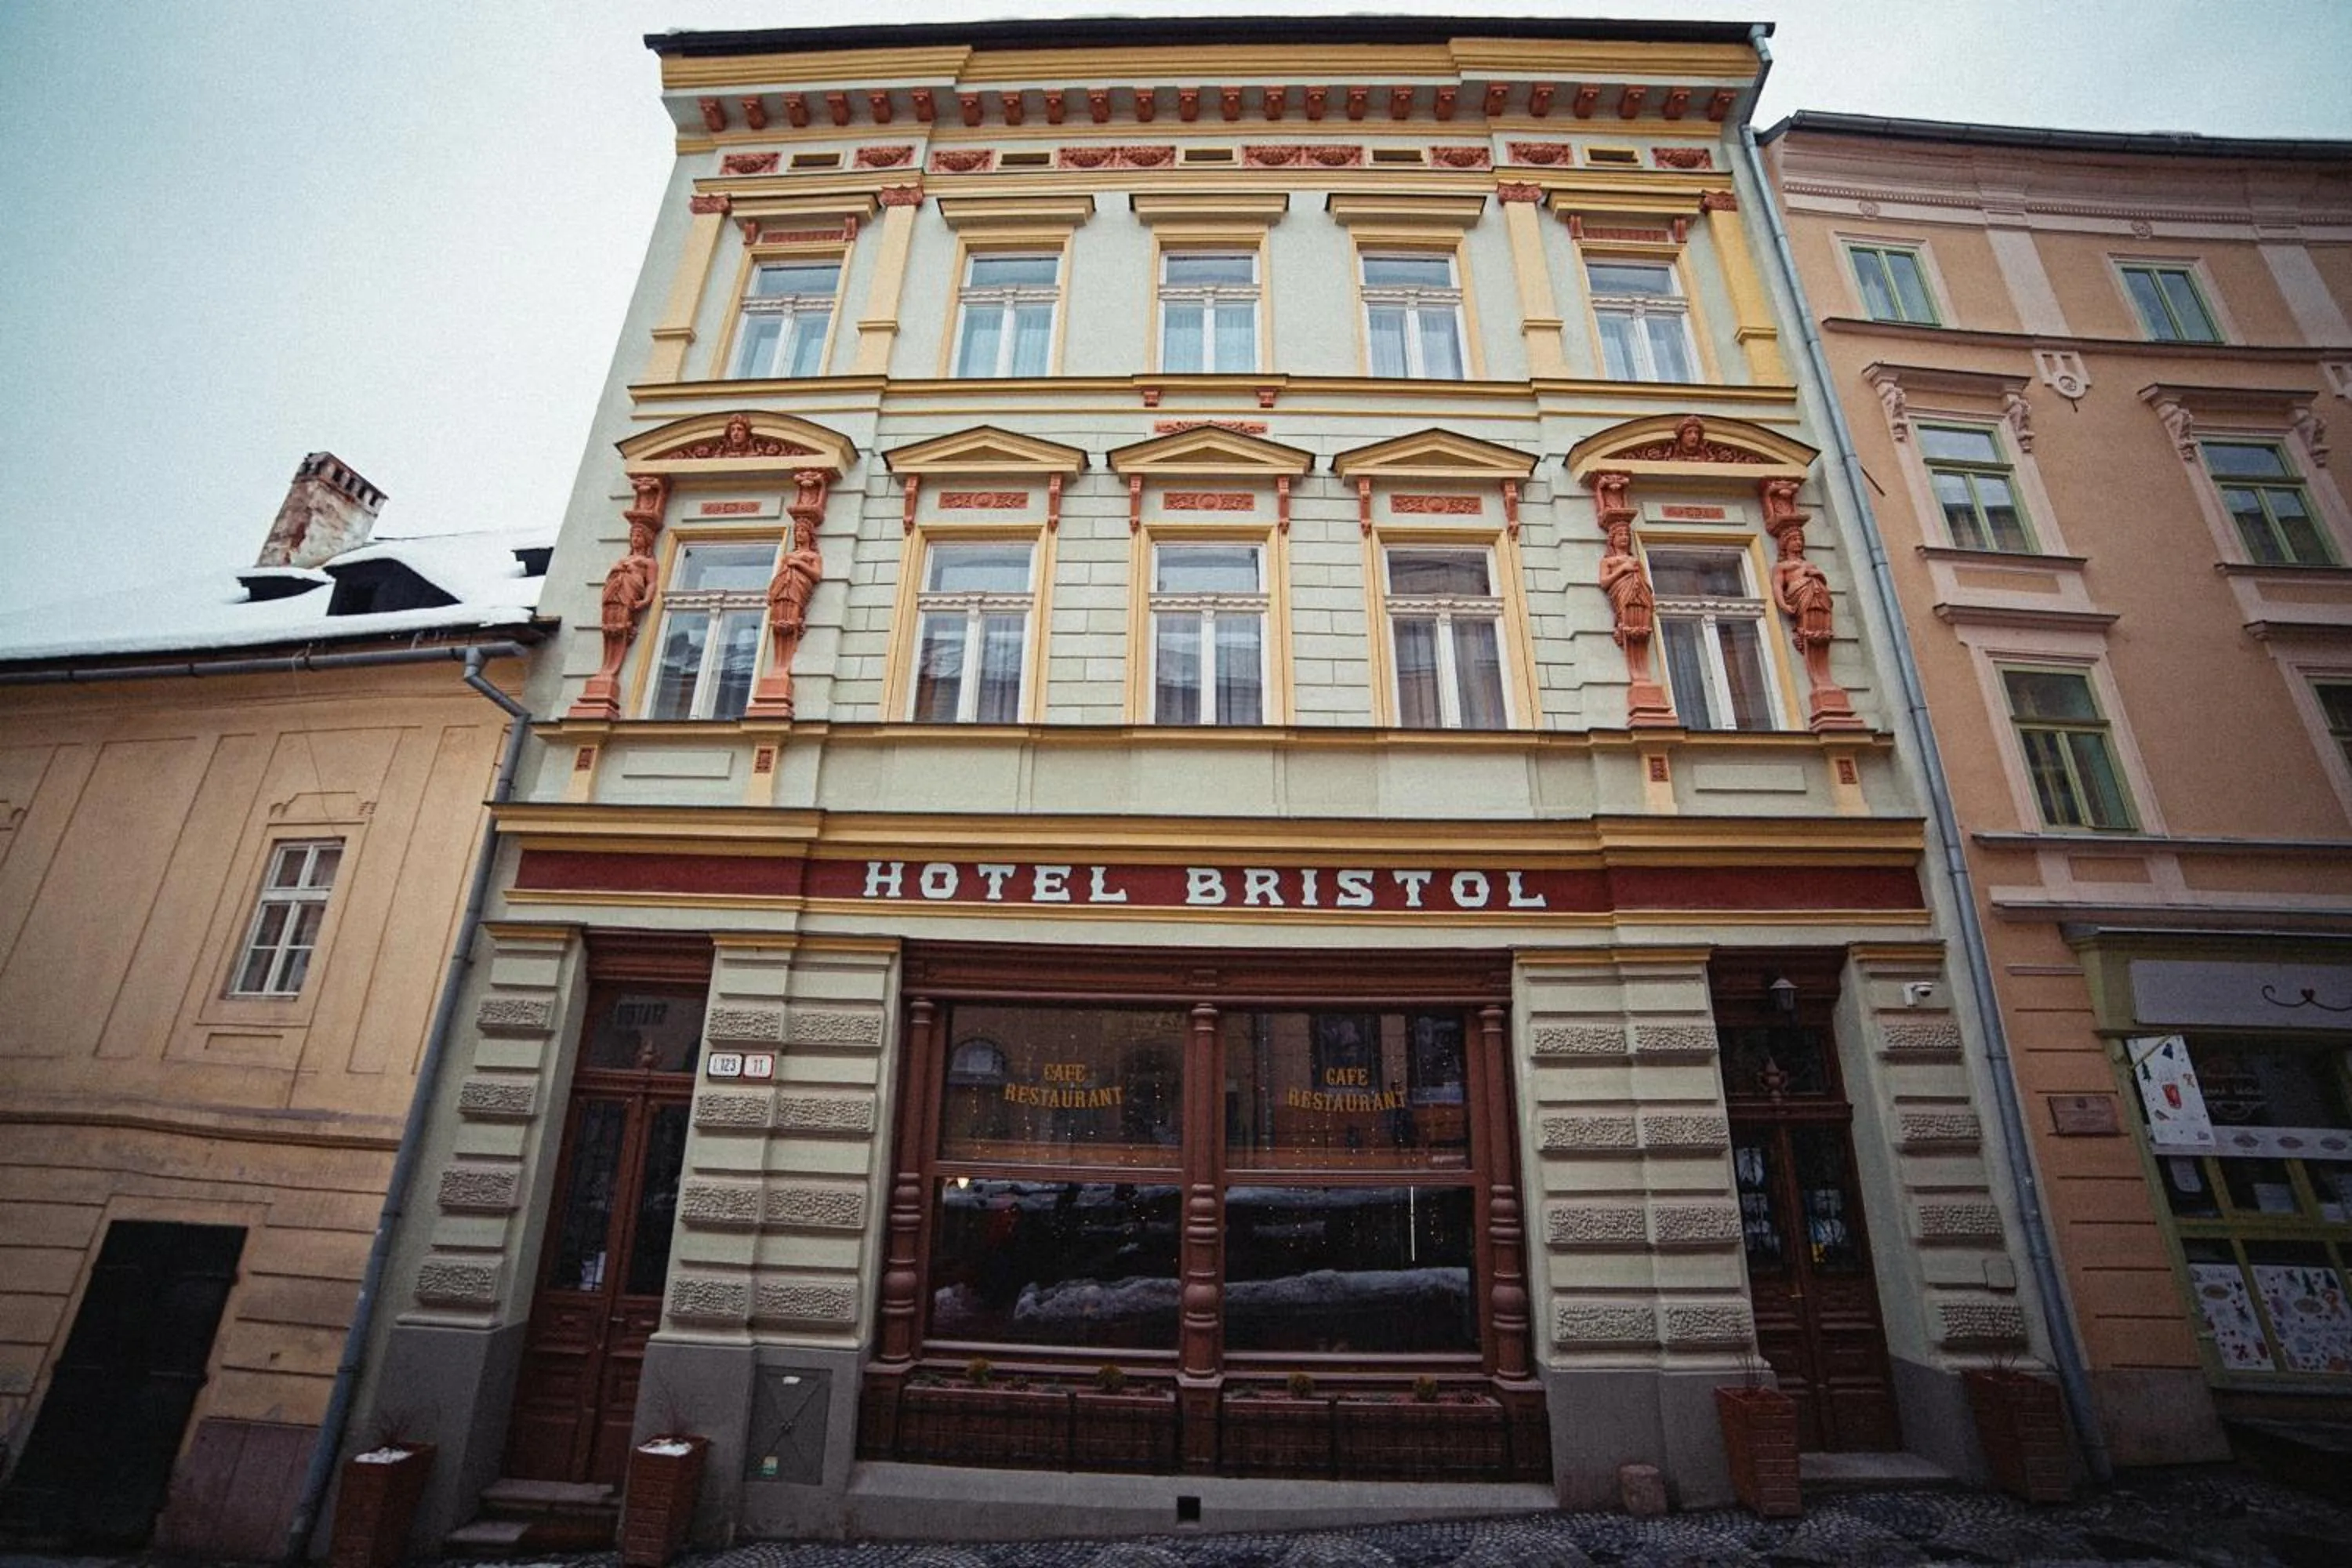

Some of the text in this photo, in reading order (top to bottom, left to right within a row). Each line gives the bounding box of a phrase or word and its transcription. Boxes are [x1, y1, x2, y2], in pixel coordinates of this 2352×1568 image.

[862, 862, 1547, 908] HOTEL BRISTOL
[1044, 1062, 1086, 1082] CAFE
[1326, 1067, 1368, 1086] CAFE
[1003, 1082, 1123, 1109] RESTAURANT
[1287, 1086, 1406, 1112] RESTAURANT
